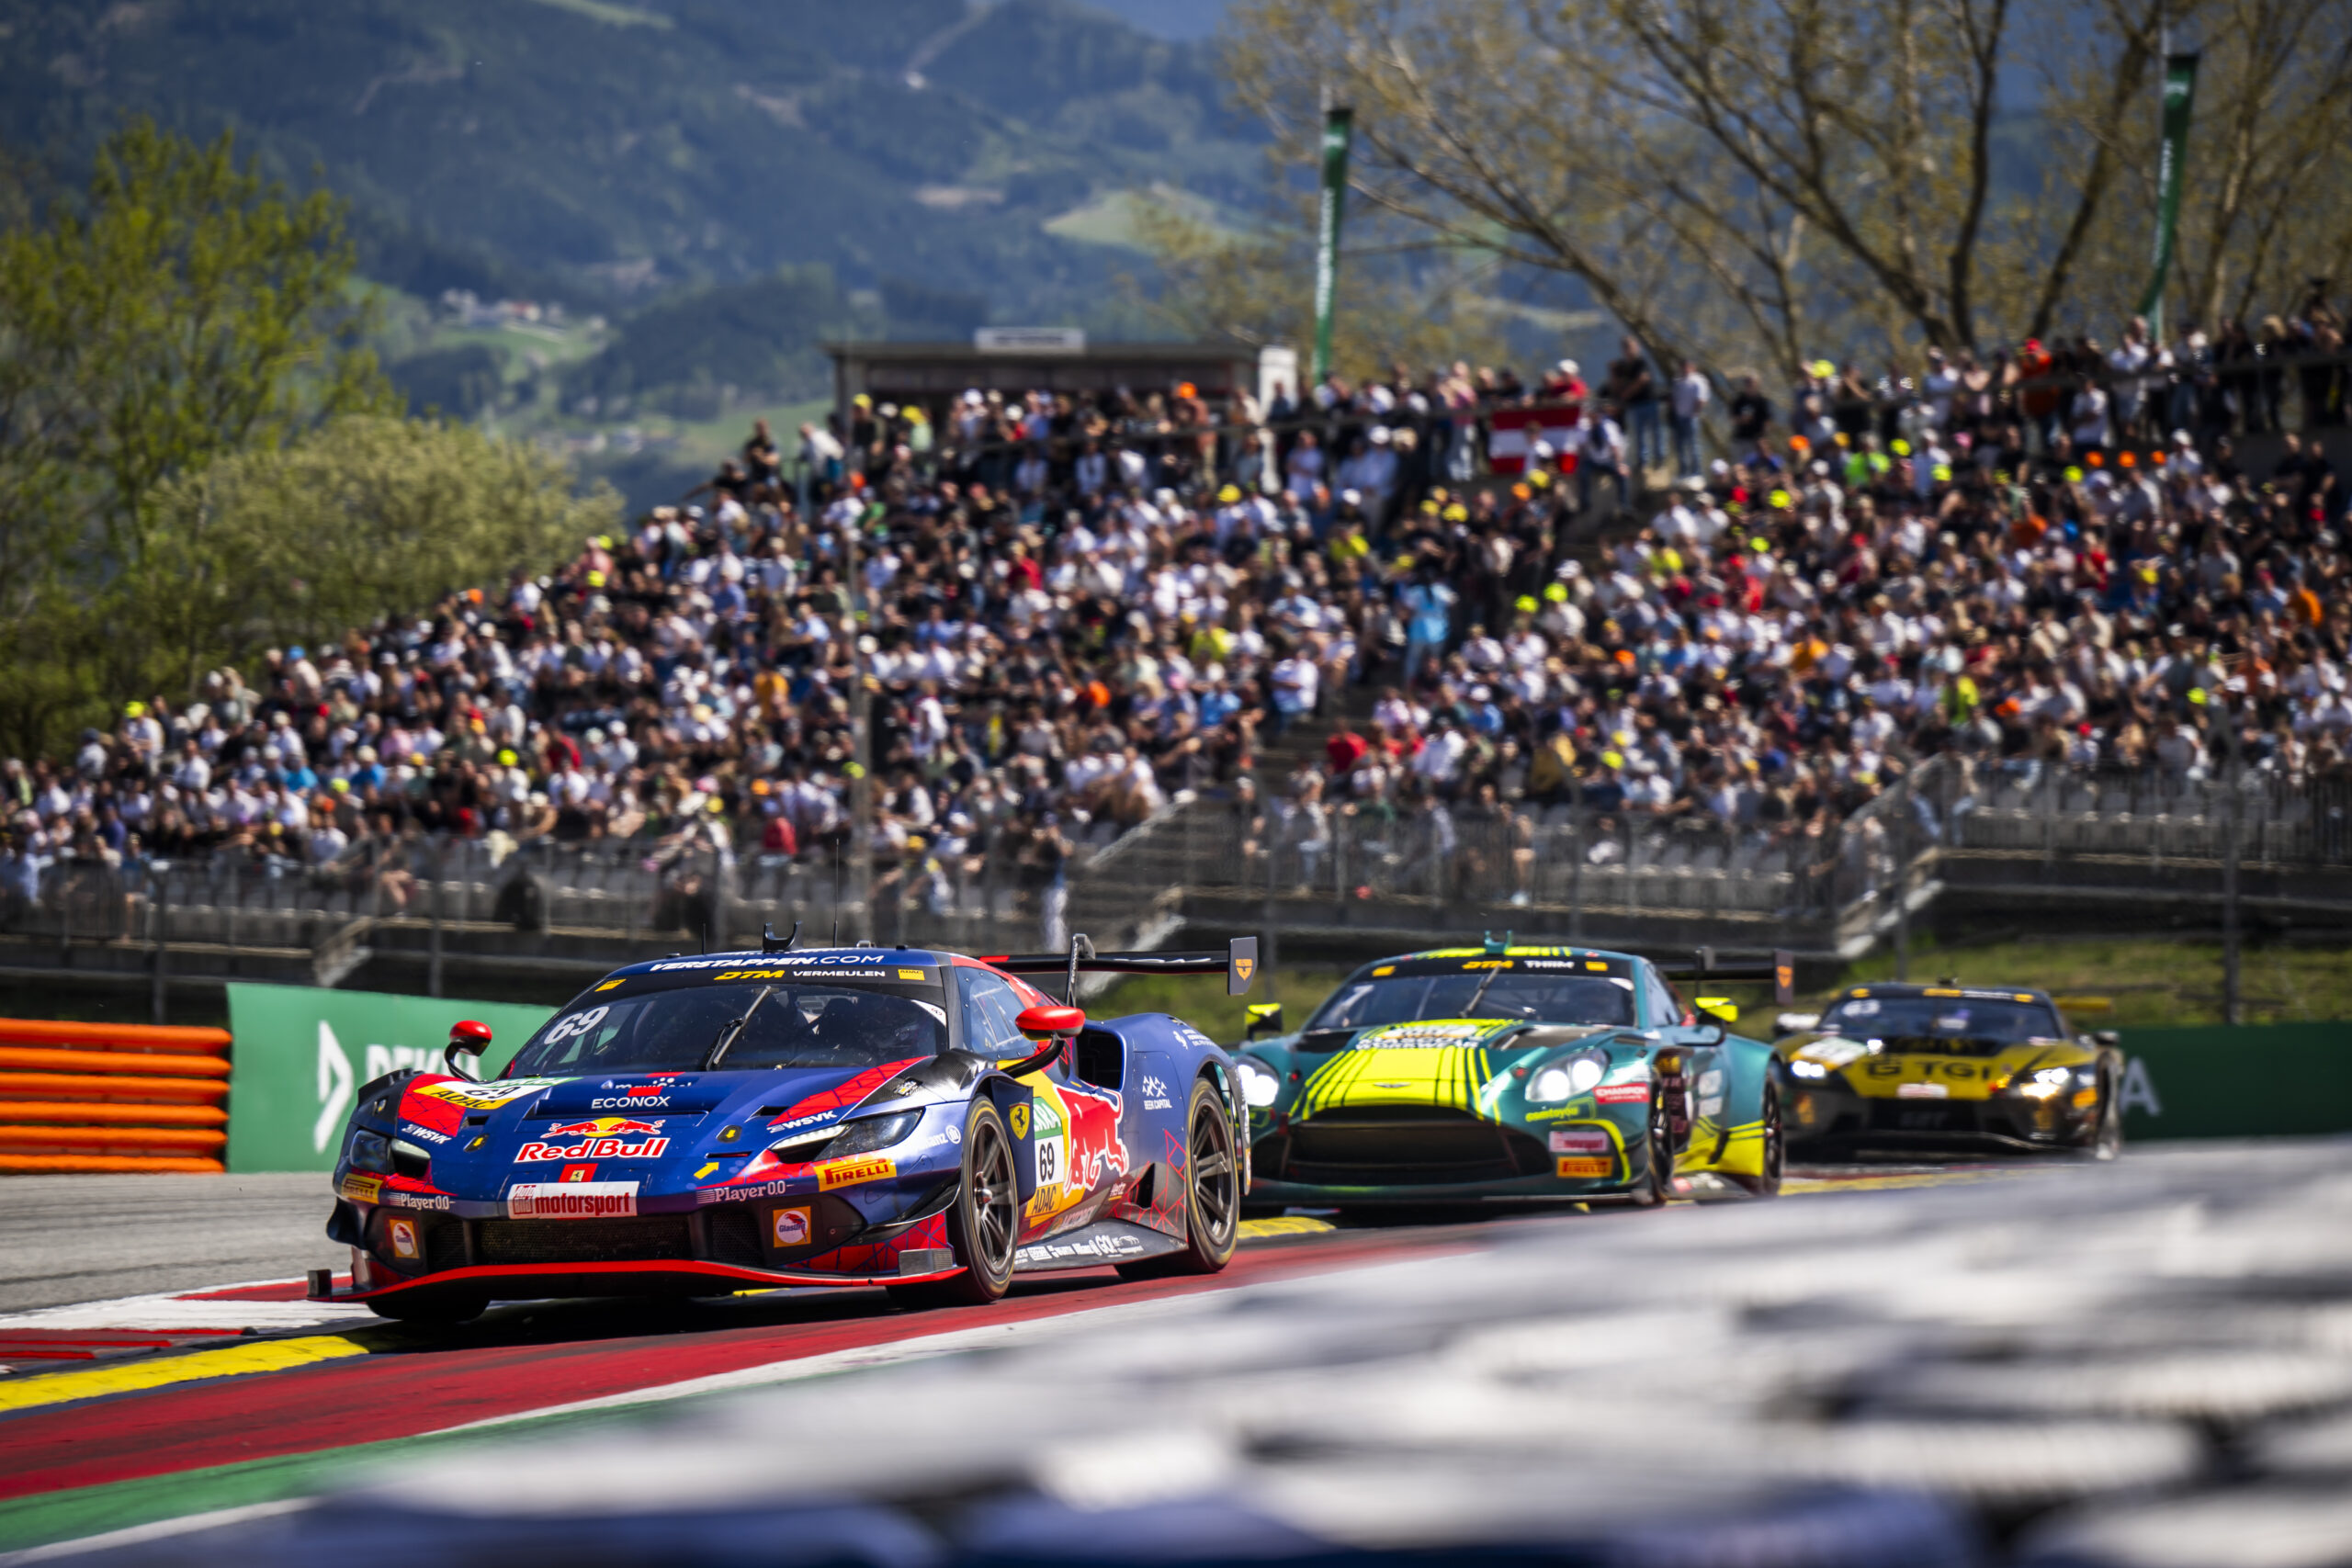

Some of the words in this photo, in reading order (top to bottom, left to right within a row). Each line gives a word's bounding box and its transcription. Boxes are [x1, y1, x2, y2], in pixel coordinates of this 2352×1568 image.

[650, 955, 885, 972] VERSTAPPEN.COM
[713, 970, 786, 981] DTM
[544, 1006, 610, 1044] 69
[430, 1090, 497, 1109] ADAC
[464, 1086, 522, 1100] 69
[591, 1096, 672, 1110] ECONOX
[782, 1110, 838, 1129] WSVK
[413, 1126, 453, 1145] WSVK
[514, 1138, 597, 1164] Red
[590, 1137, 672, 1158] Bull
[824, 1157, 889, 1185] PIRELLI
[1039, 1142, 1056, 1183] 69
[400, 1193, 435, 1211] Player
[714, 1185, 767, 1202] Player
[1032, 1187, 1057, 1214] ADAC
[536, 1192, 629, 1216] motorsport
